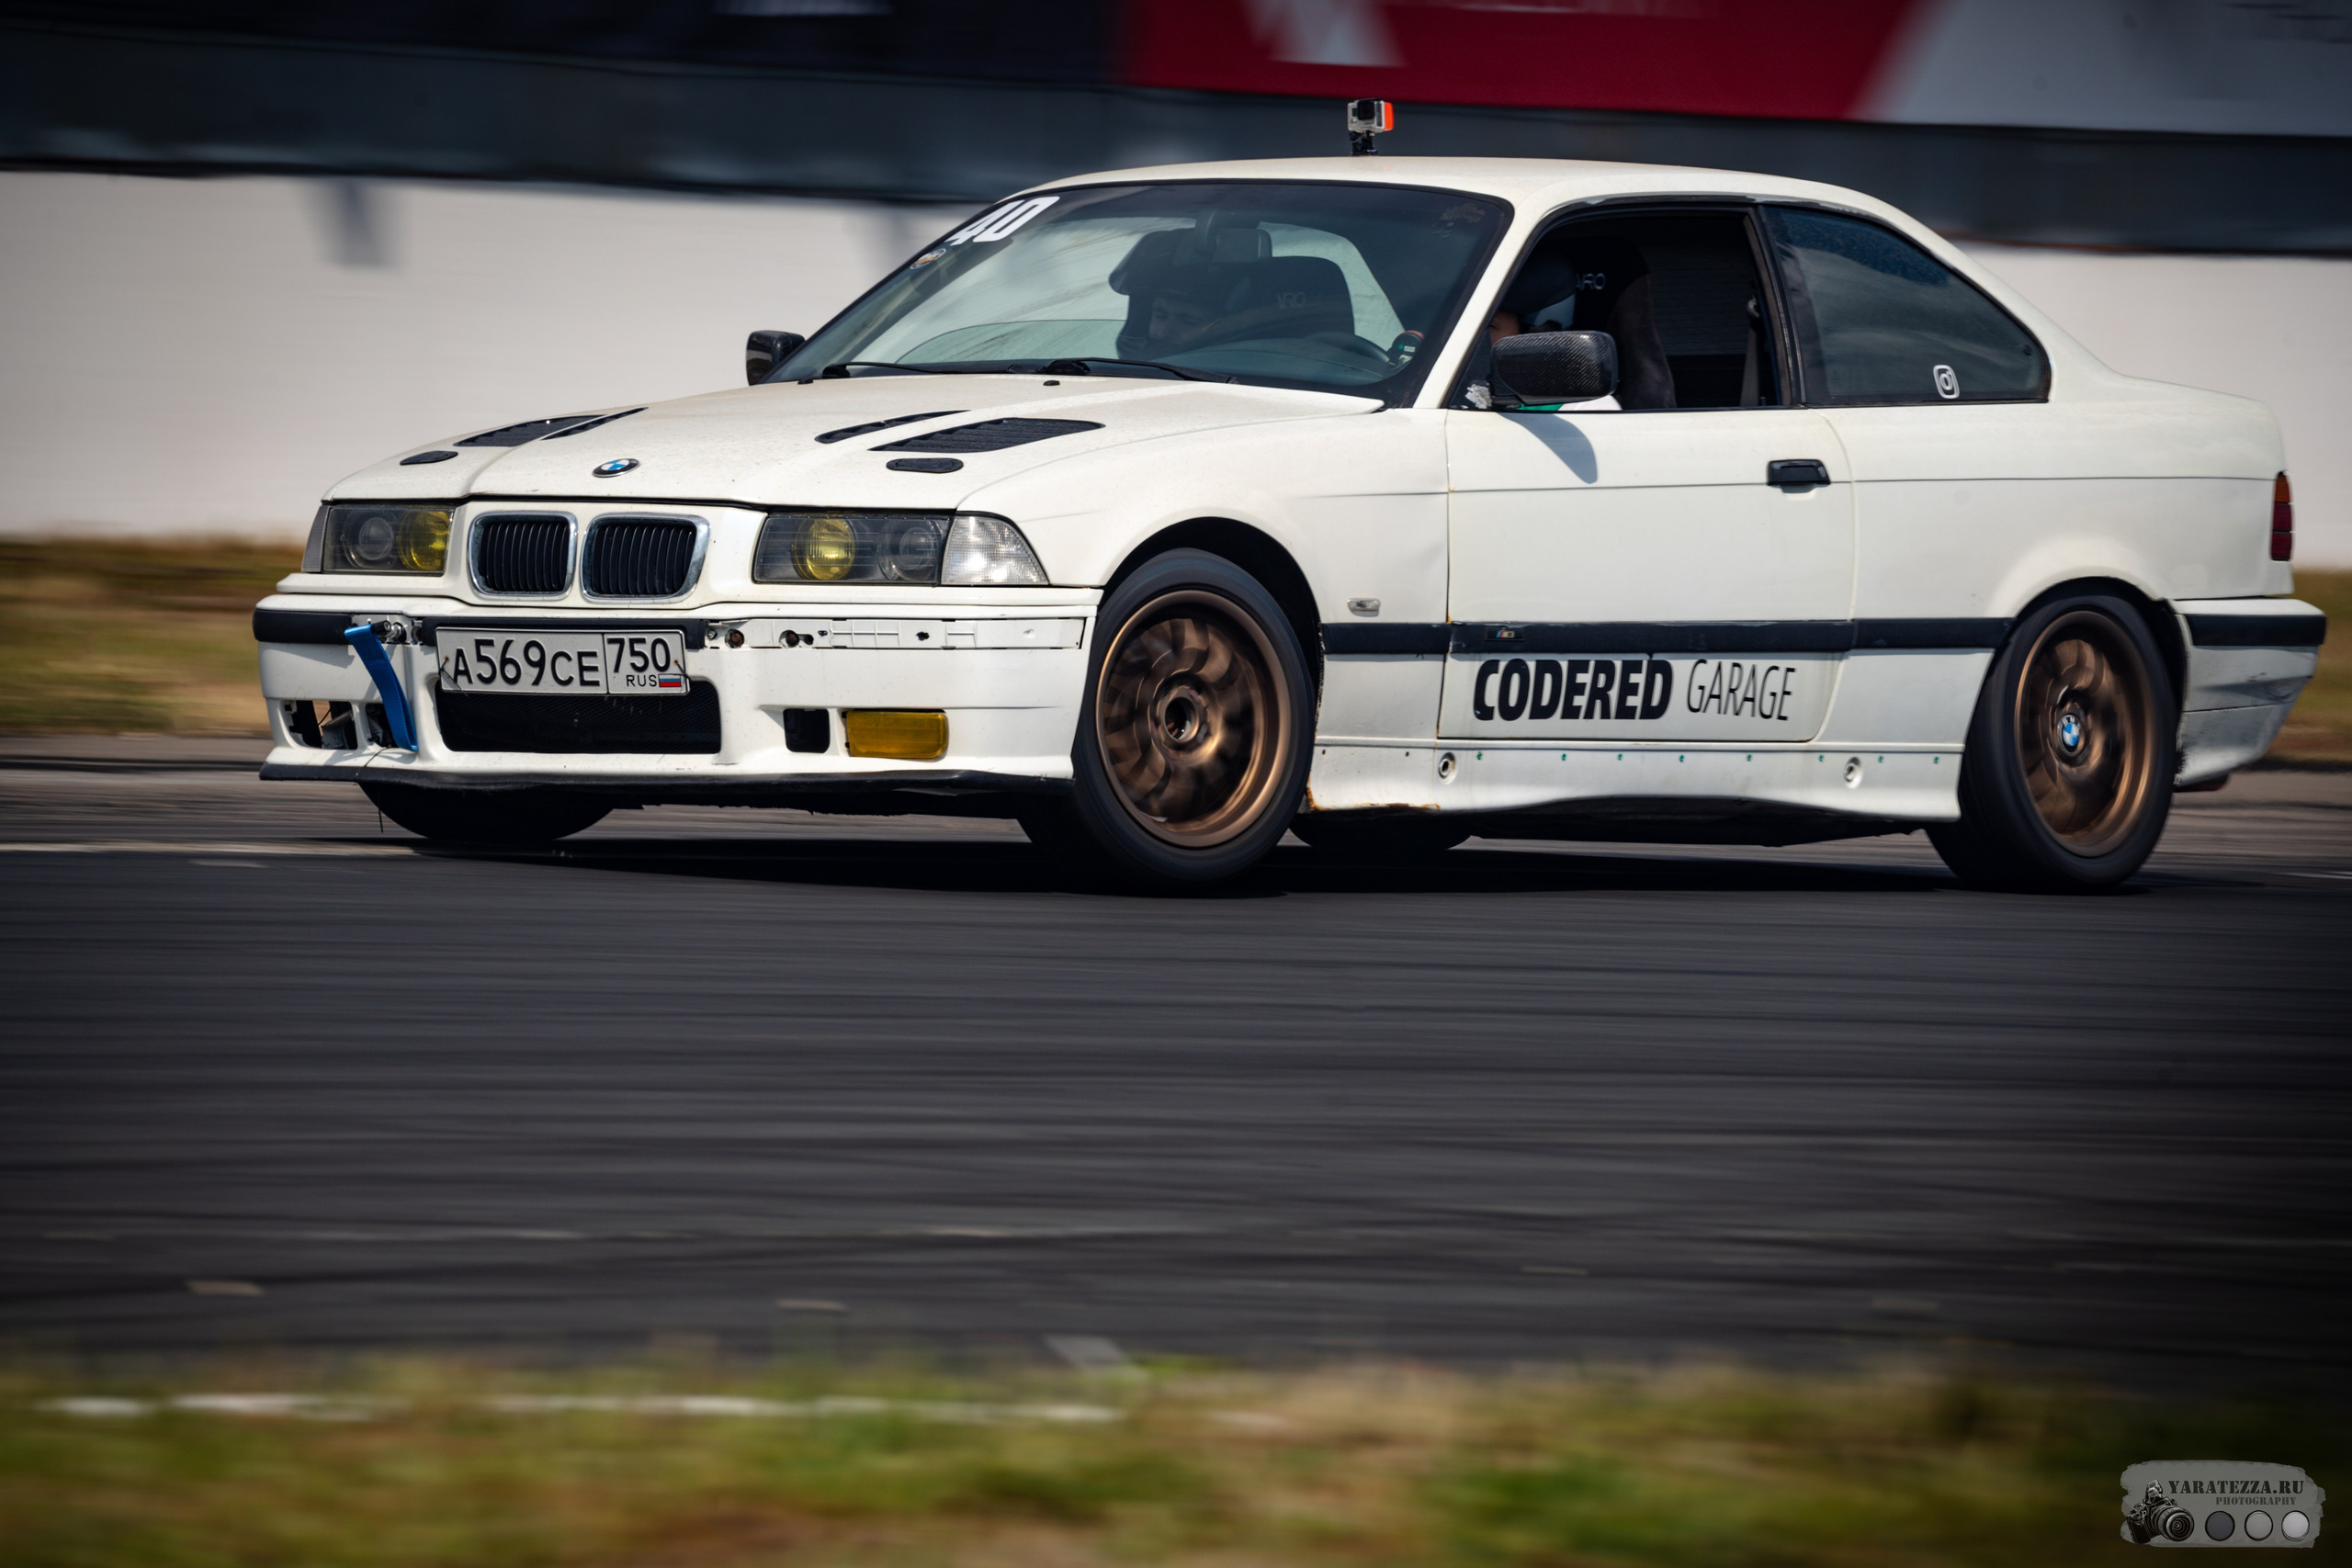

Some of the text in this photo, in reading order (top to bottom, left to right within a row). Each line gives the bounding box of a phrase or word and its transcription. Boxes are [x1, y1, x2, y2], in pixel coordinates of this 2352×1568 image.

[944, 196, 1060, 246] 40
[453, 637, 672, 687] A569CE 750
[626, 674, 658, 688] RUS
[1474, 659, 1796, 721] CODERED GARAGE
